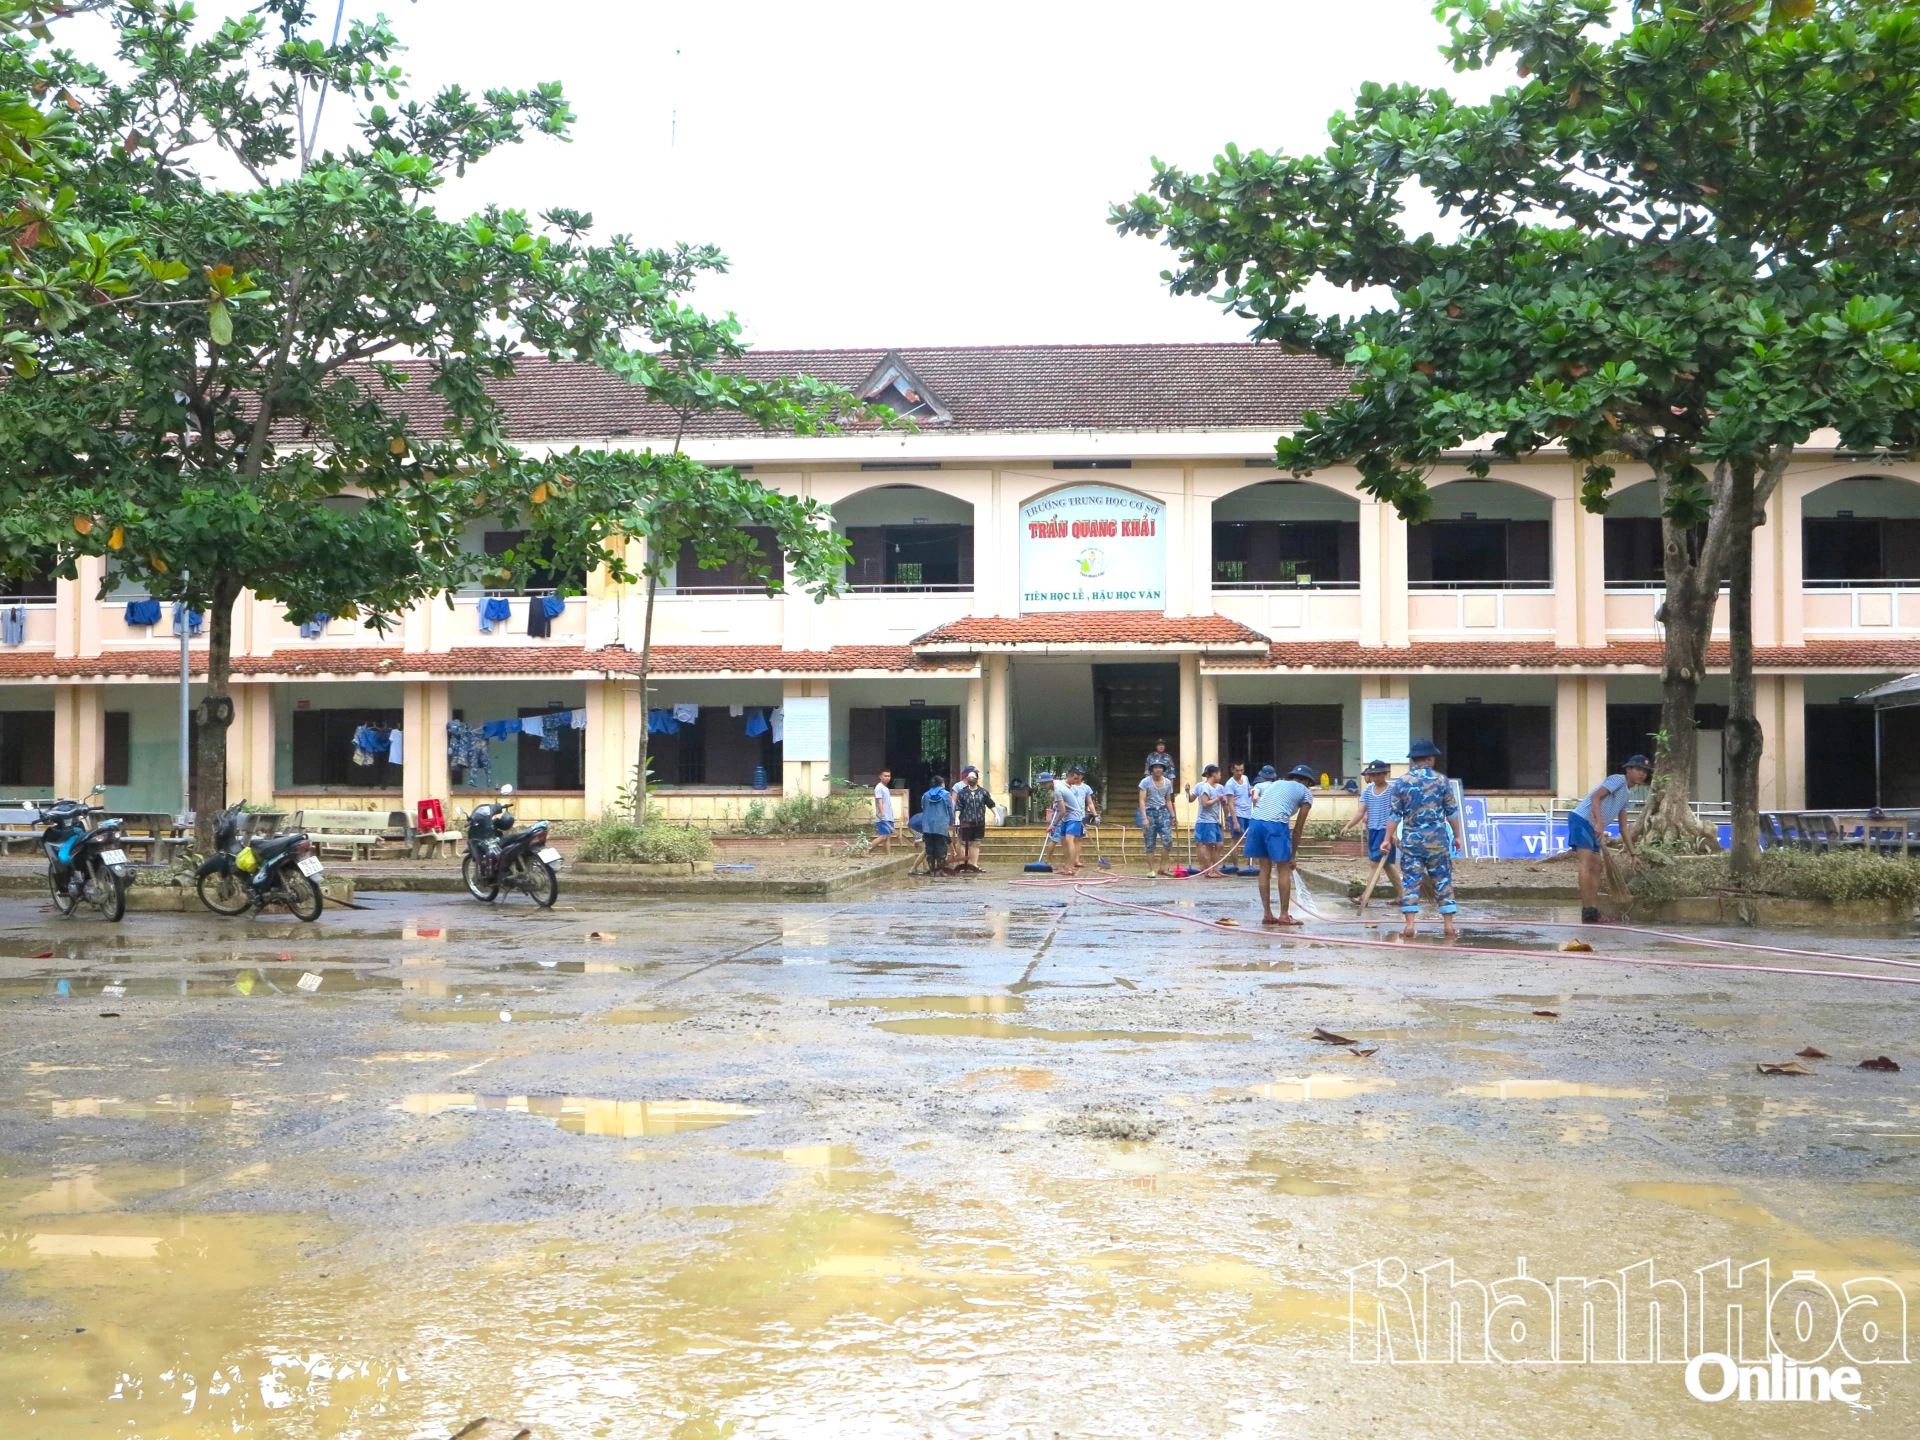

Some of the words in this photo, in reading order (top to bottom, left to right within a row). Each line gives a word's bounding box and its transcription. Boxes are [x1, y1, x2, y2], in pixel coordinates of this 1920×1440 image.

[1068, 496, 1103, 506] TRUNG
[1105, 496, 1128, 507] HỌC
[1129, 500, 1144, 510] CƠ
[1072, 519, 1117, 539] QUANG
[1121, 513, 1155, 537] KHẢI
[1024, 591, 1048, 601] TIÊN
[1050, 592, 1070, 602] HỌC
[1092, 590, 1113, 602] HẬU
[1116, 591, 1136, 601] HỌC
[1522, 831, 1549, 854] VÌ
